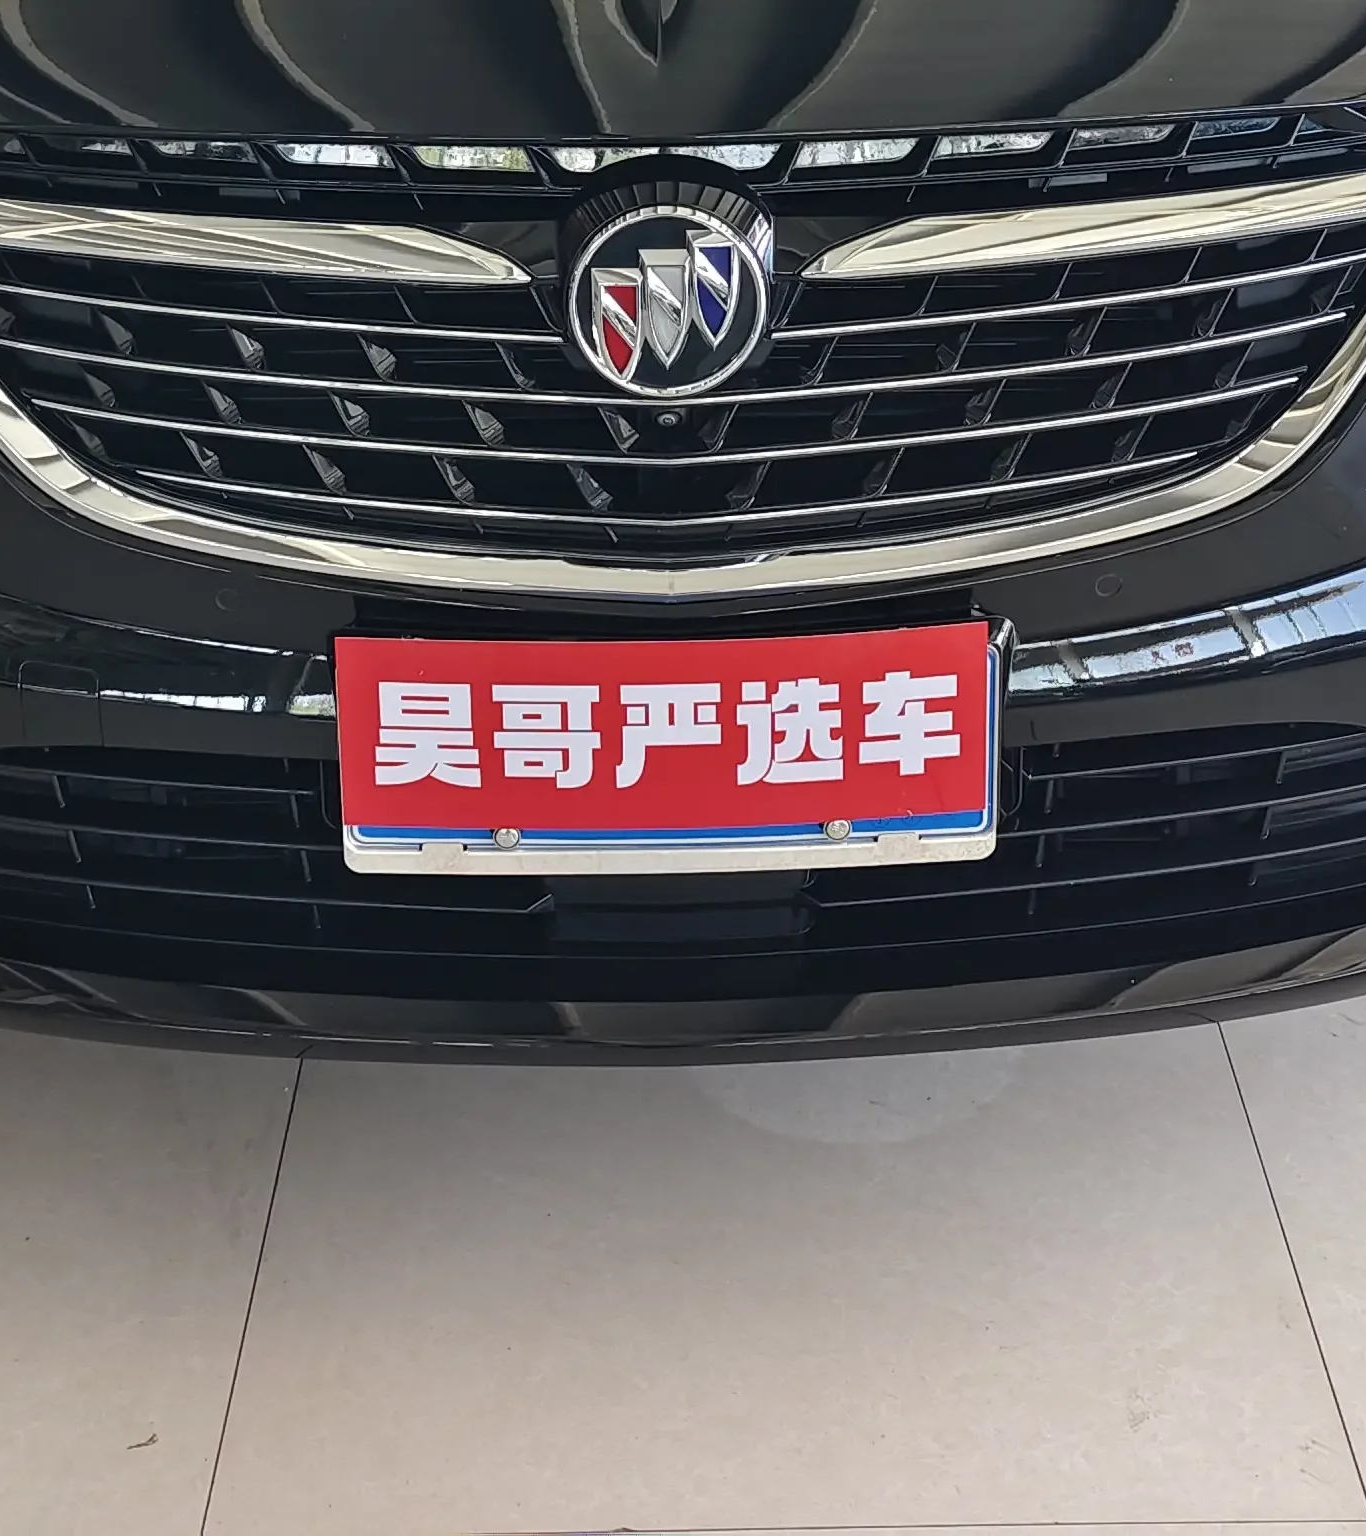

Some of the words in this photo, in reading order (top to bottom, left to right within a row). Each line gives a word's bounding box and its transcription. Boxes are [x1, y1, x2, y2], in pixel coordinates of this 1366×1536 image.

[374, 671, 961, 789] 昊哥严选车
